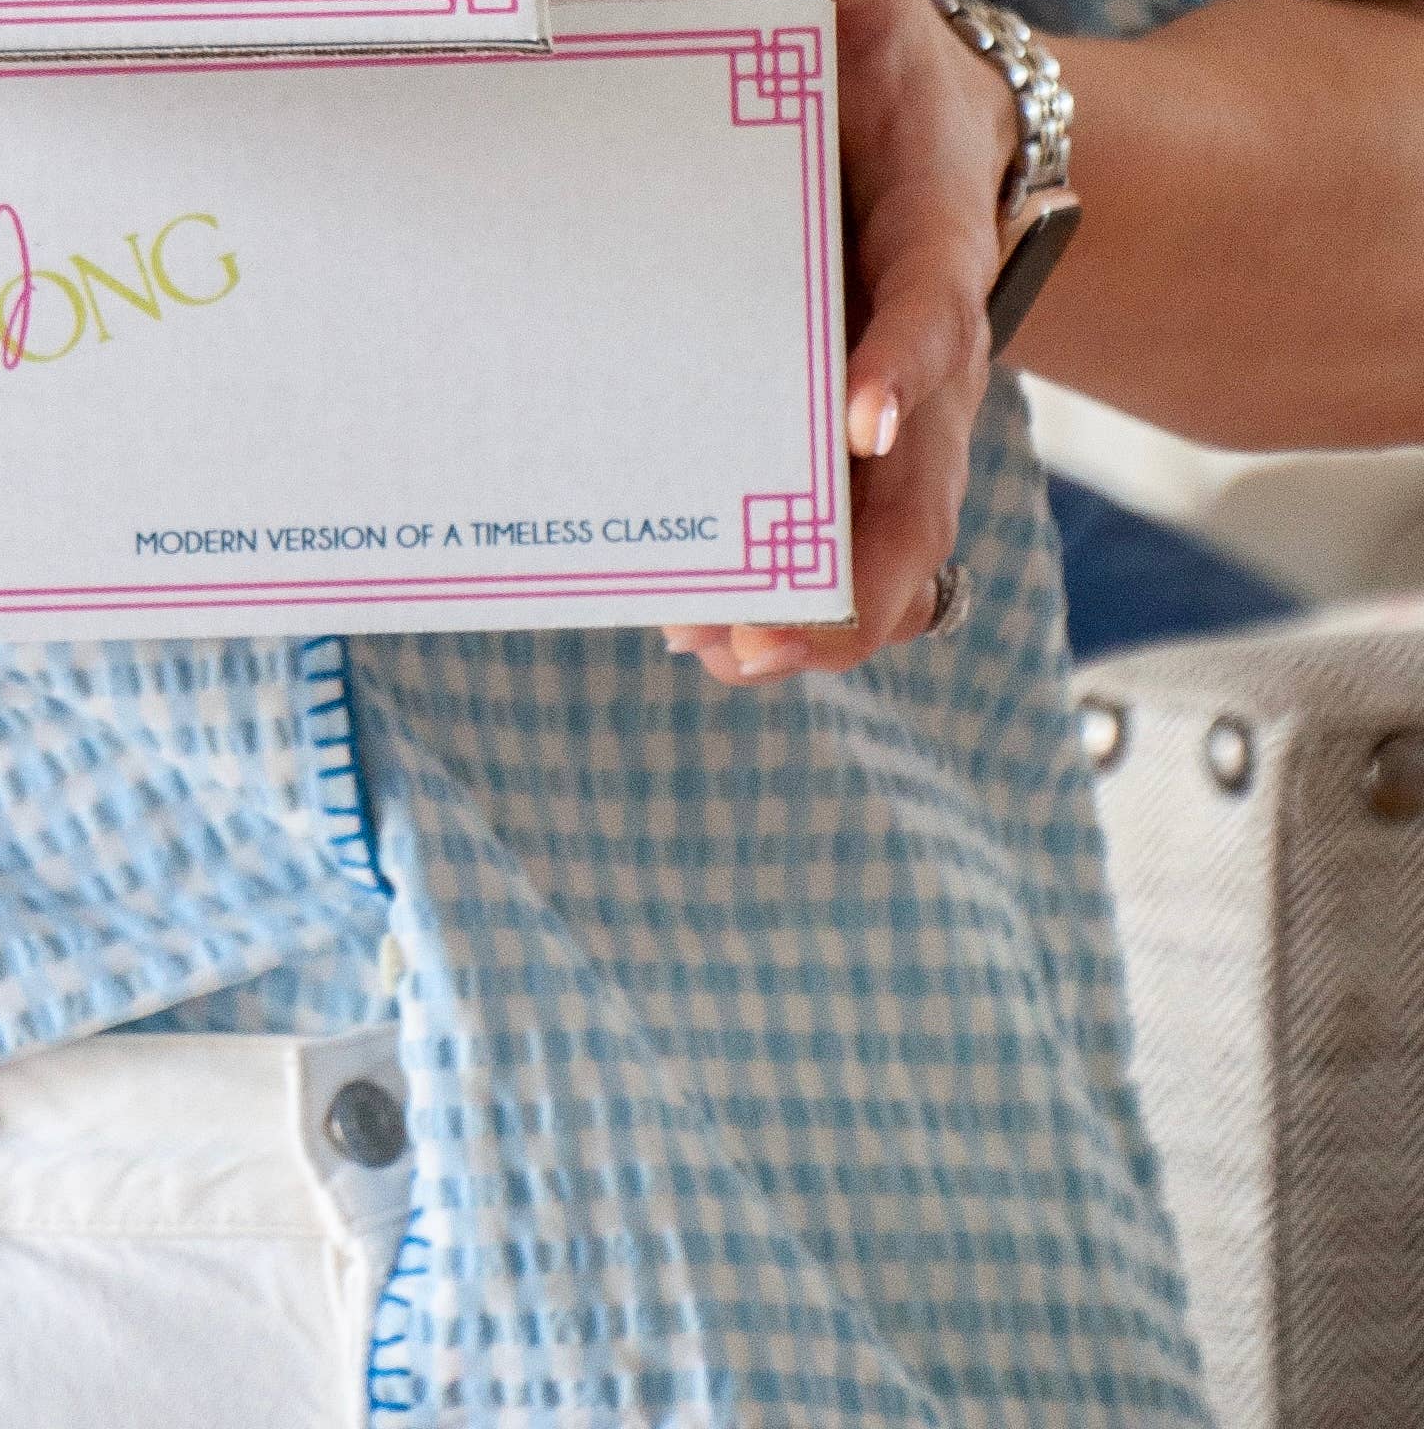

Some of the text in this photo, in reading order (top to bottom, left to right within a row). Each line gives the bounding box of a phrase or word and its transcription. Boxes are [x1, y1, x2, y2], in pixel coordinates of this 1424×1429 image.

[133, 514, 720, 557] MODERN VERSION OF A TIMELESS CLASSIC
